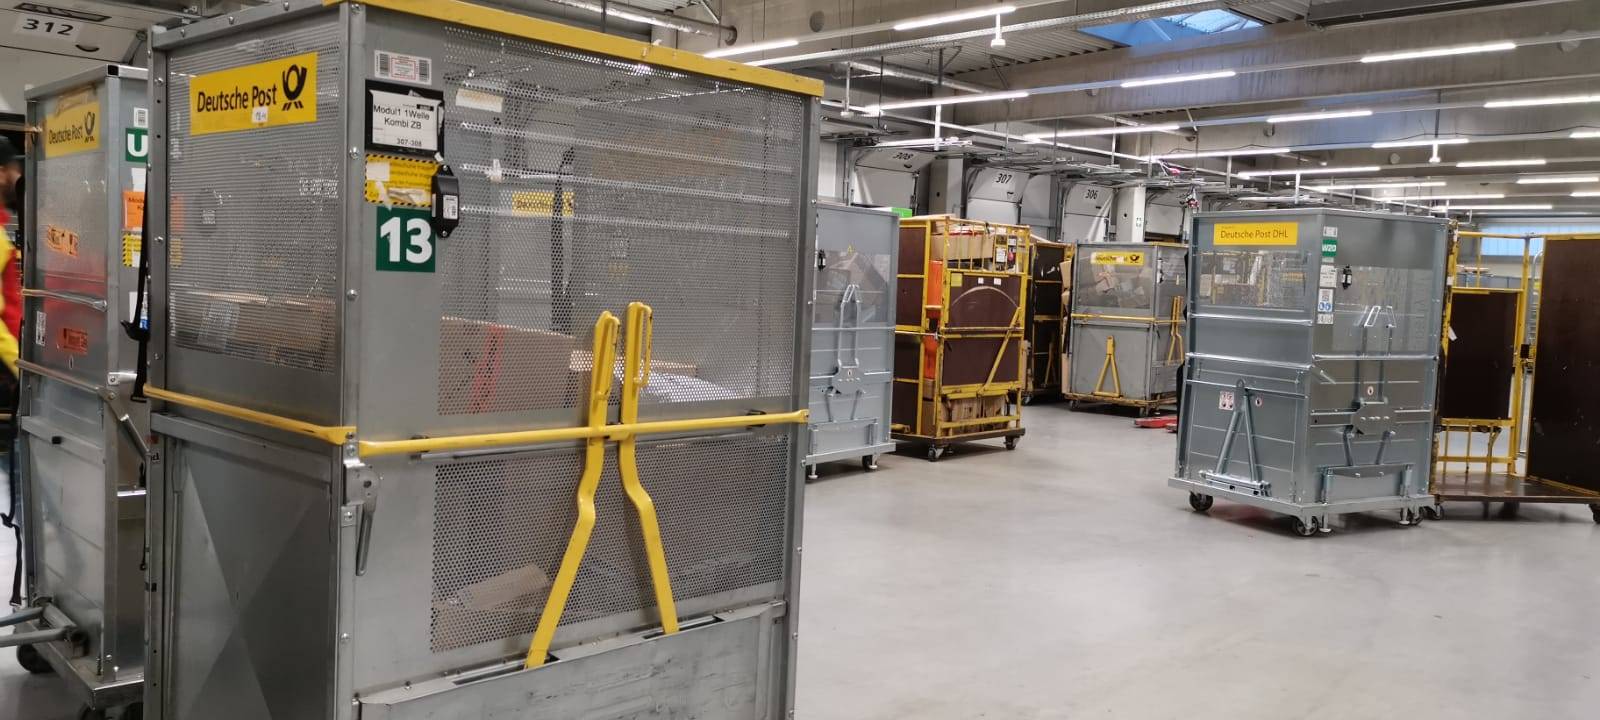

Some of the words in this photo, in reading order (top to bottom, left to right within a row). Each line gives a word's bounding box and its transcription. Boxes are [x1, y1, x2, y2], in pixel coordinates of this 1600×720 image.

[23, 18, 73, 36] 312
[197, 86, 249, 112] Deutsche
[251, 83, 277, 108] Post
[373, 104, 401, 116] Modul1
[404, 109, 430, 120] 1Welle
[384, 116, 409, 128] Kombi
[410, 120, 422, 130] ZB
[48, 125, 72, 144] Deutsche
[71, 123, 84, 140] Post
[995, 172, 1013, 184] 307
[1085, 188, 1099, 200] 306
[380, 216, 433, 264] 13
[1220, 228, 1254, 239] Deutsche
[1254, 228, 1271, 239] Post
[1272, 228, 1289, 239] DHL
